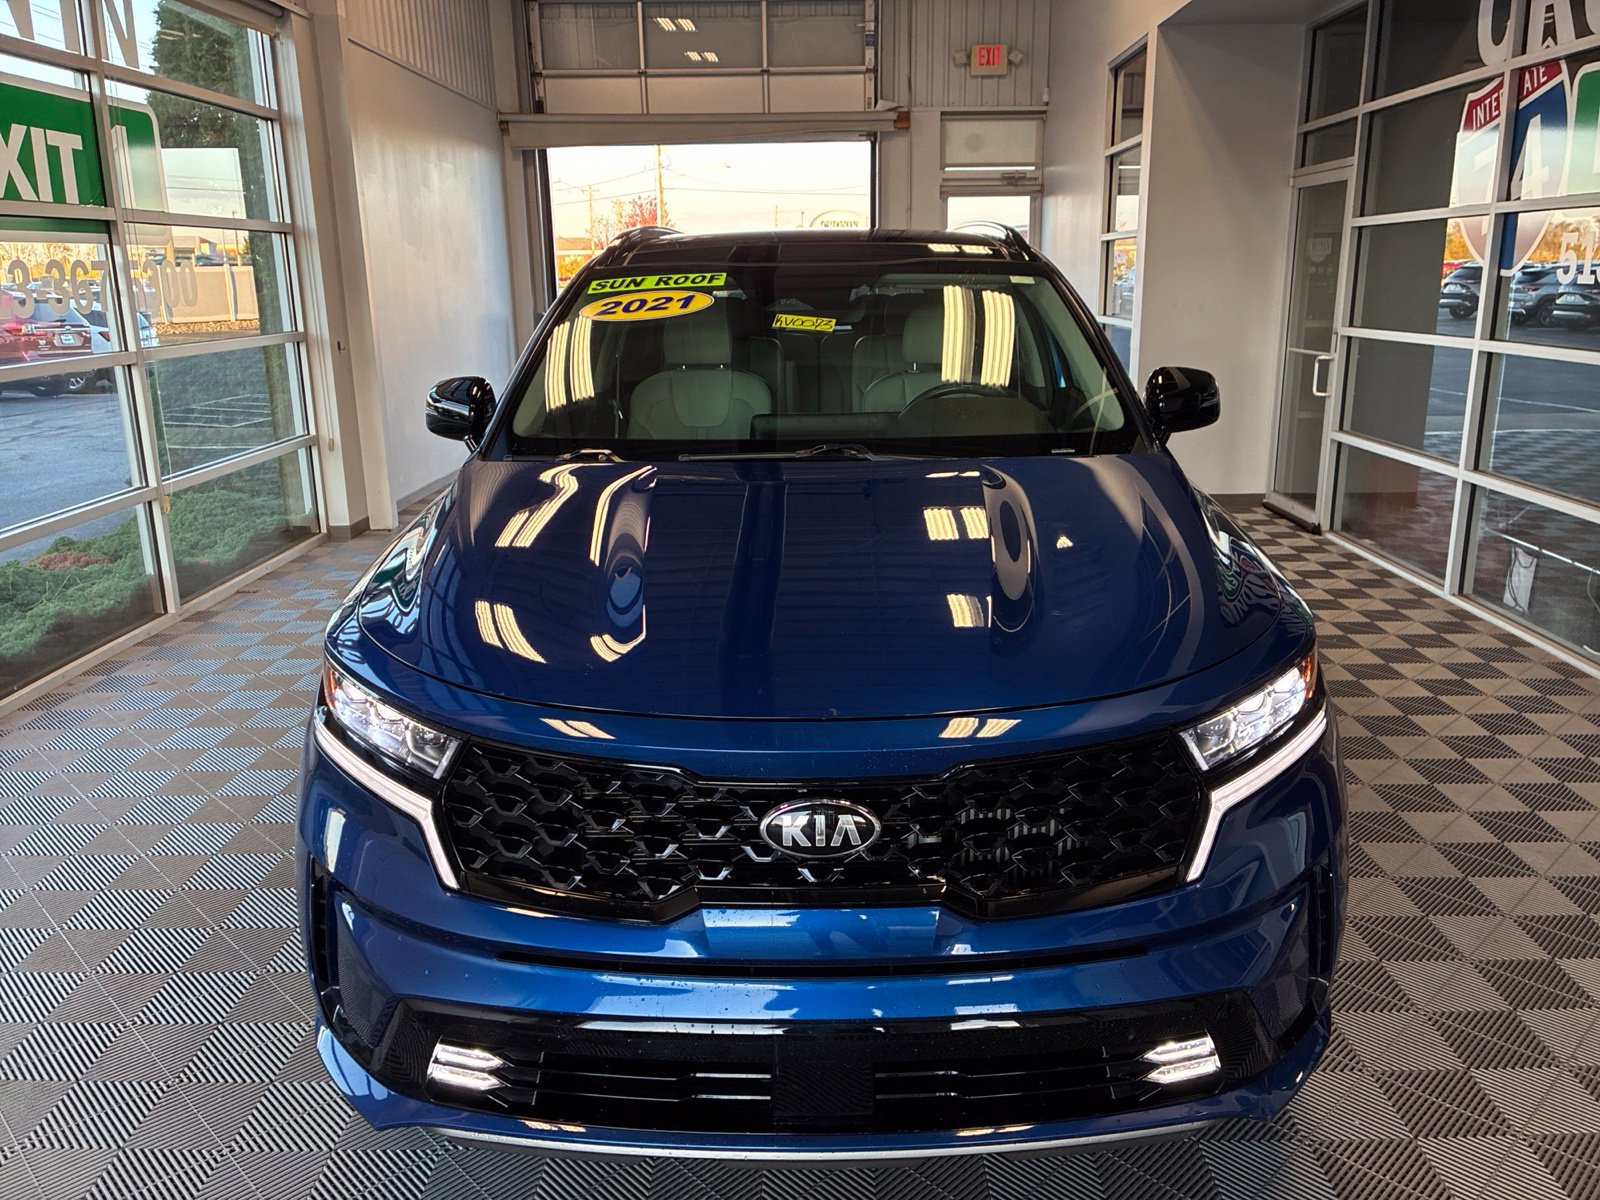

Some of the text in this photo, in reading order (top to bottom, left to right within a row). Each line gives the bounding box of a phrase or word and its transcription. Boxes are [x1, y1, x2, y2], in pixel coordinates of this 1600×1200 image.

[977, 45, 1003, 66] EXIT
[1472, 65, 1548, 131] INTEATE
[1556, 231, 1600, 285] 51
[591, 273, 723, 291] SUN ROOF
[594, 294, 696, 317] 2021
[781, 814, 862, 847] KIA
